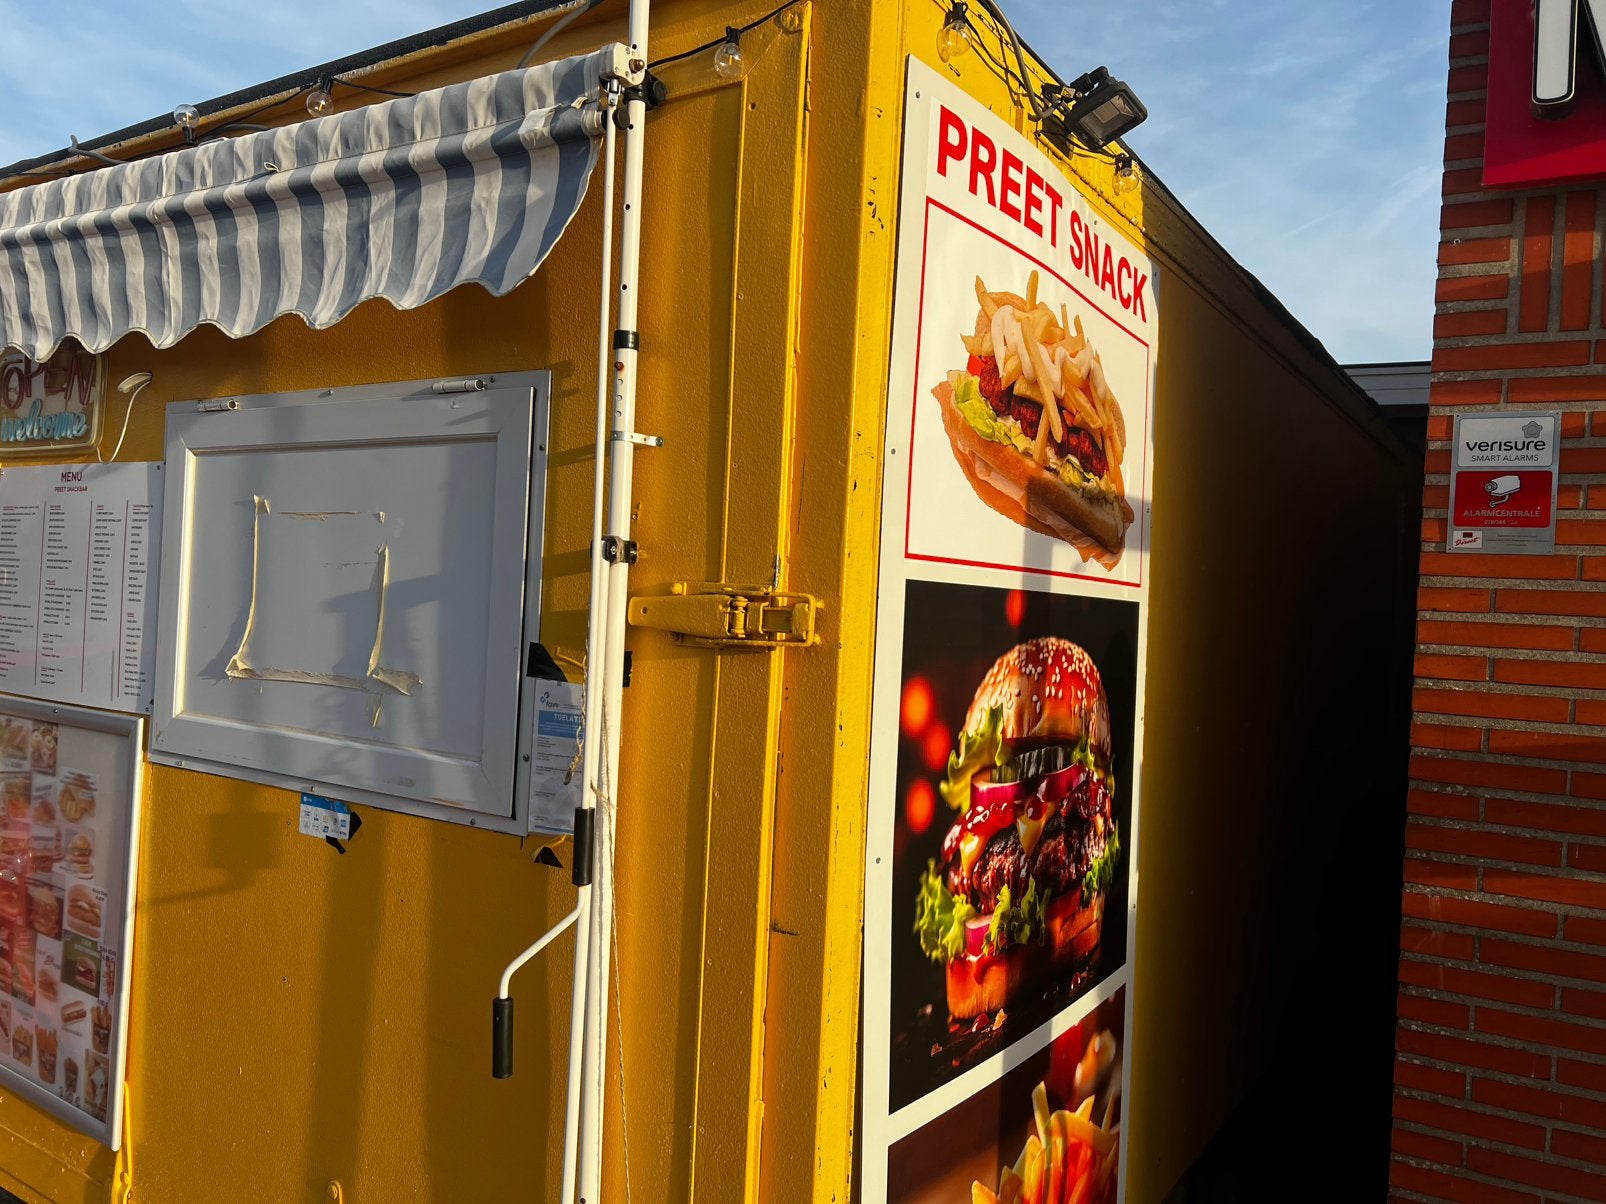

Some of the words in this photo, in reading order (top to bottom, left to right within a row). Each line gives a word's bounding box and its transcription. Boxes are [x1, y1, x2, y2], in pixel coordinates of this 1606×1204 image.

[937, 104, 1063, 248] PREET
[1069, 209, 1148, 324] SNACK
[1, 398, 88, 442] welcome
[1465, 440, 1546, 452] verisure
[1471, 454, 1501, 463] SMART
[1502, 454, 1539, 462] ALARMS
[60, 471, 83, 483] MENU
[66, 485, 88, 493] SNACKBAR
[1463, 508, 1541, 518] ALARMCENTRALE
